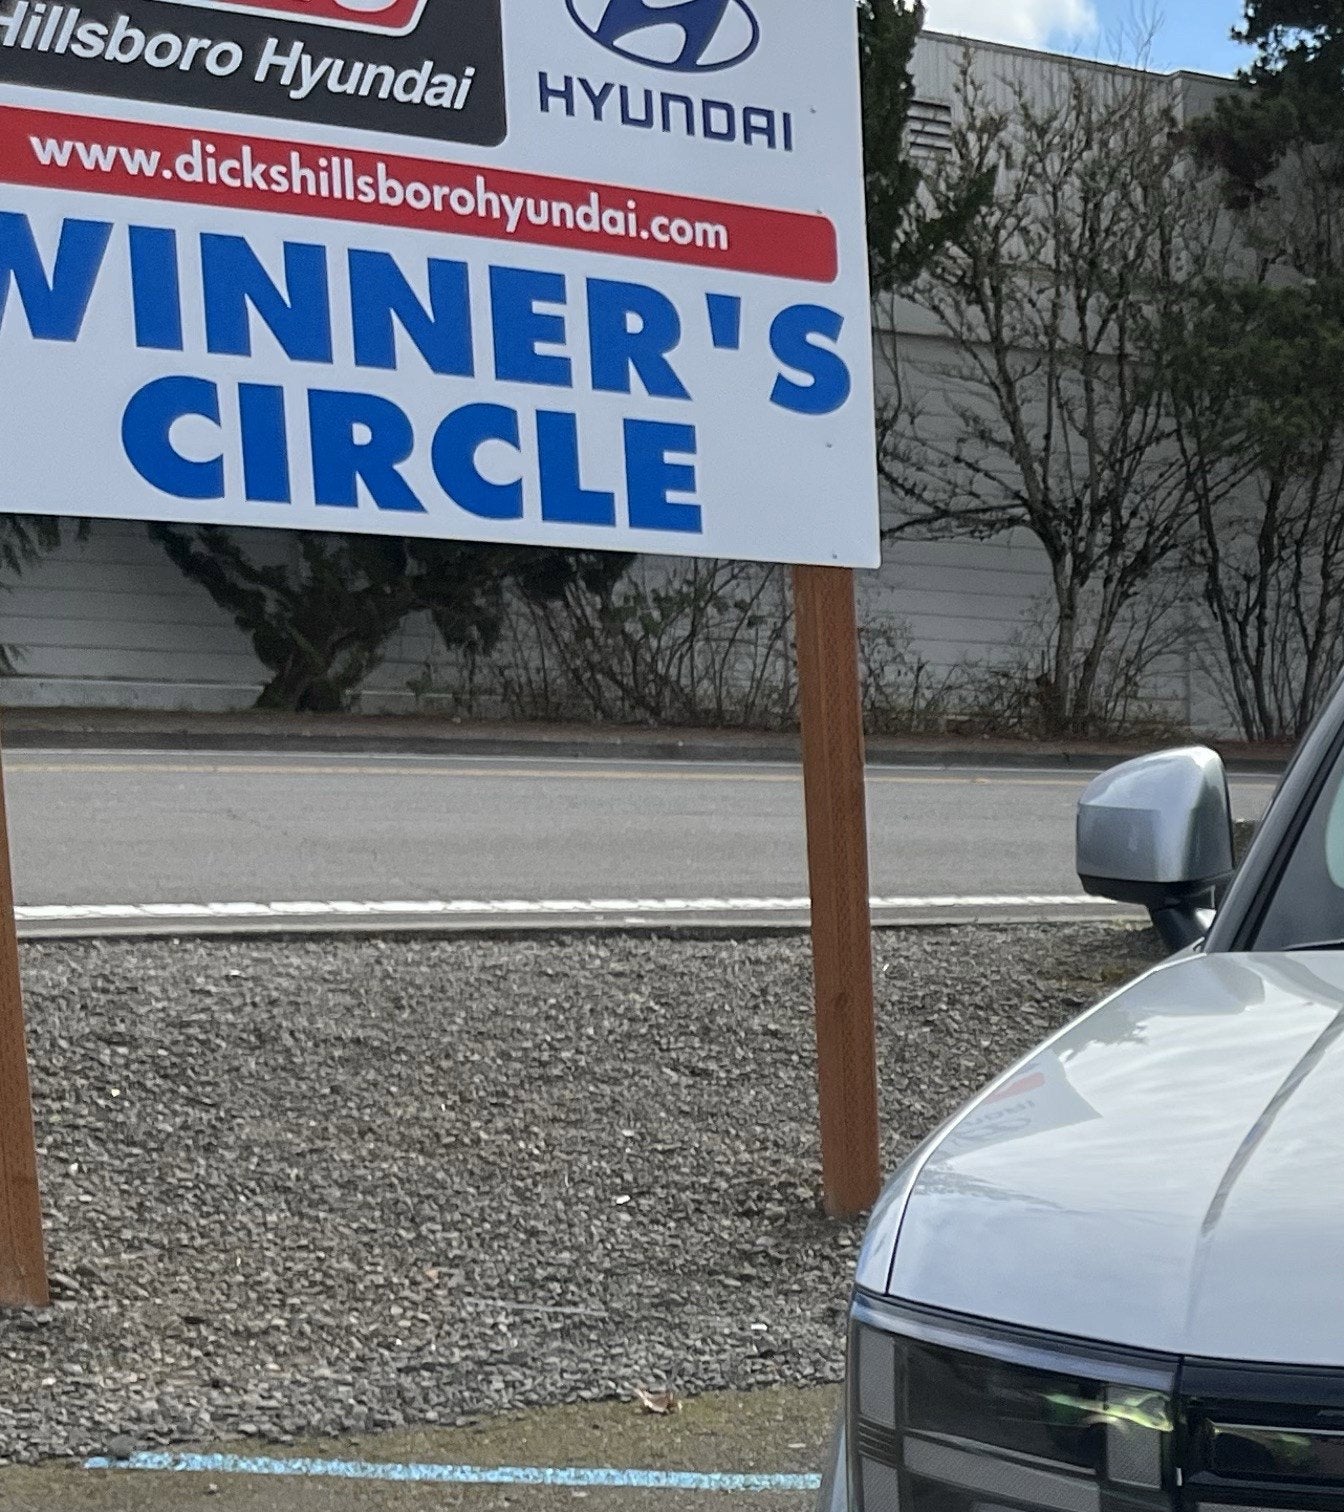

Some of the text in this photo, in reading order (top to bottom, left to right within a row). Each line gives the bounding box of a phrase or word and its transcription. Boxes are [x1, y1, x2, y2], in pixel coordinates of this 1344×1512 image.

[0, 0, 476, 112] Hillsboro Hyundai
[537, 70, 794, 152] HYUNDAI
[29, 134, 729, 252] www.dickshillsborohyundai.com
[0, 210, 852, 416] WINNER'S
[121, 374, 704, 535] CIRCLE
